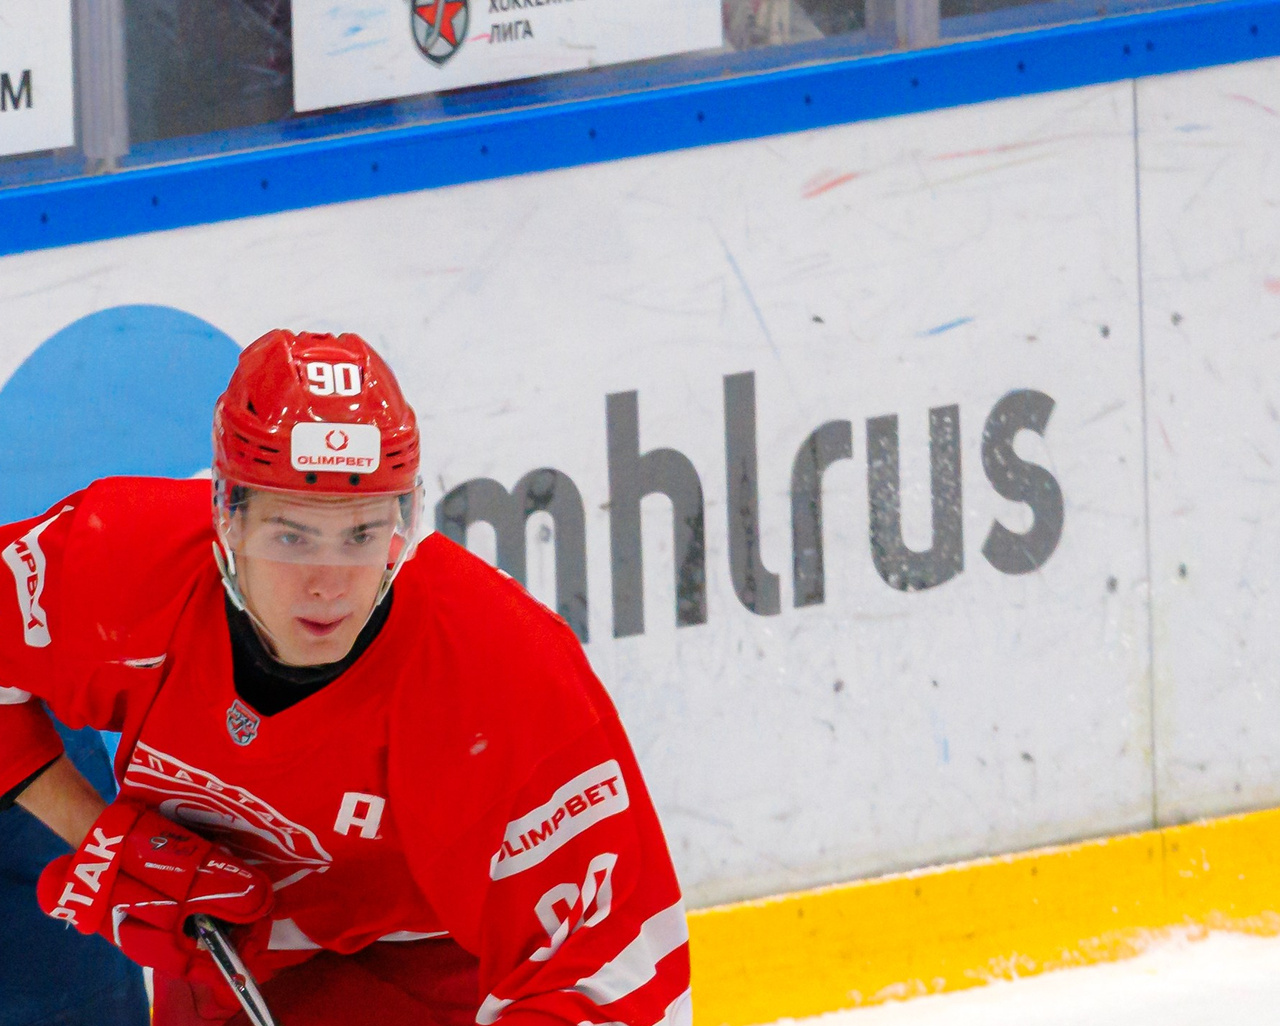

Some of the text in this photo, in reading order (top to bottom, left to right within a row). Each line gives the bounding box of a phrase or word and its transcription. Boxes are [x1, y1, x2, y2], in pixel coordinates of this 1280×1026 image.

[488, 19, 533, 43] ЛИГА
[306, 361, 362, 396] 90
[297, 455, 375, 467] OLIMPBET
[435, 370, 1065, 644] mhlrus
